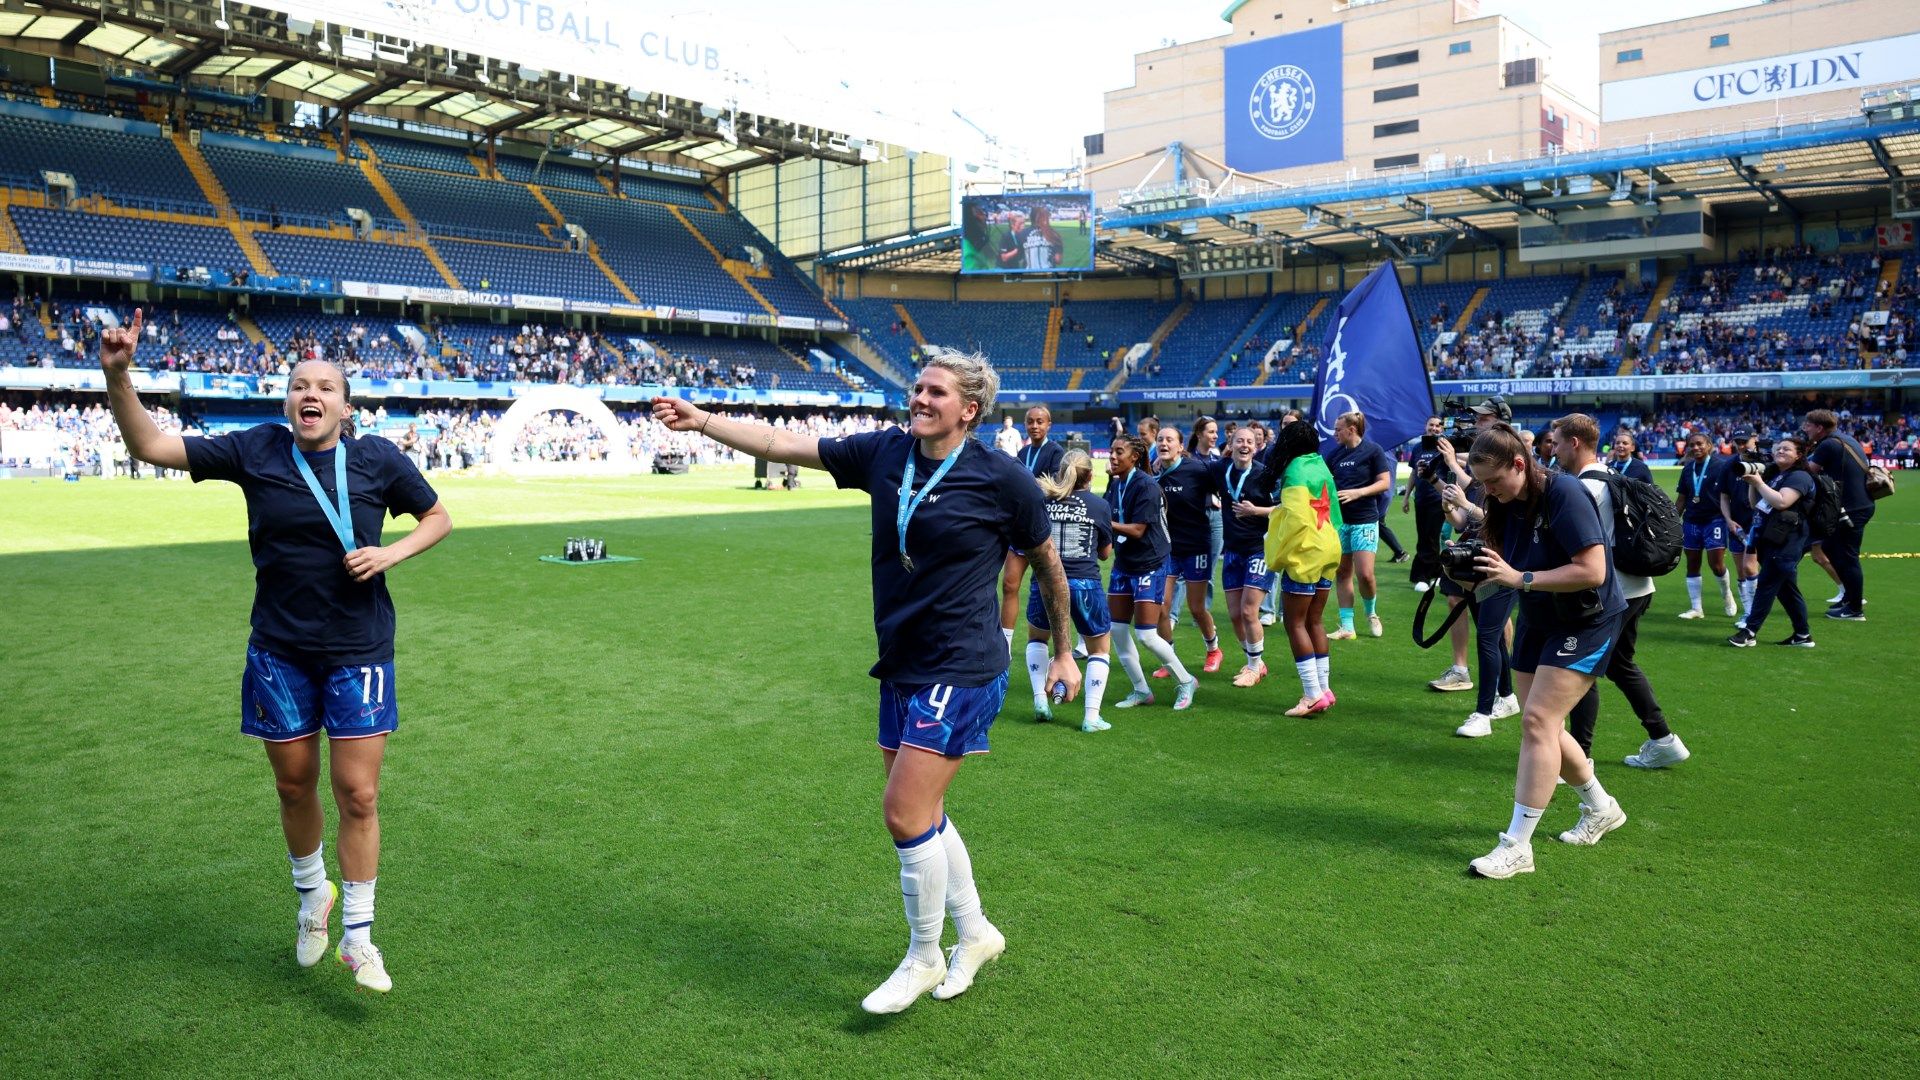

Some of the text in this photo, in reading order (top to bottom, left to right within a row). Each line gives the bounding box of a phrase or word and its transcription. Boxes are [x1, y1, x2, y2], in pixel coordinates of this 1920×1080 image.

[430, 0, 720, 71] OOTBALL CLUB
[1260, 67, 1303, 88] CHELSEA
[1693, 52, 1864, 102] CFC LDN
[1260, 118, 1304, 136] FOOTBALL CLUB
[87, 260, 114, 269] ULSTER
[115, 262, 147, 272] CHELSEA
[418, 286, 454, 296] THAILAND
[469, 292, 501, 305] MIZO
[1462, 383, 1498, 392] THE PRI
[1511, 380, 1571, 393] TAMBLING 202
[1587, 375, 1750, 391] BORN IS THE KING
[1143, 391, 1156, 400] THE
[1157, 391, 1177, 400] PRIDE
[1187, 390, 1217, 399] LONDON
[1048, 512, 1095, 525] AMPIONS
[1713, 526, 1722, 540] 9
[1195, 553, 1208, 569] 18
[1249, 557, 1268, 576] 30
[360, 665, 384, 704] 11
[928, 683, 954, 721] 4
